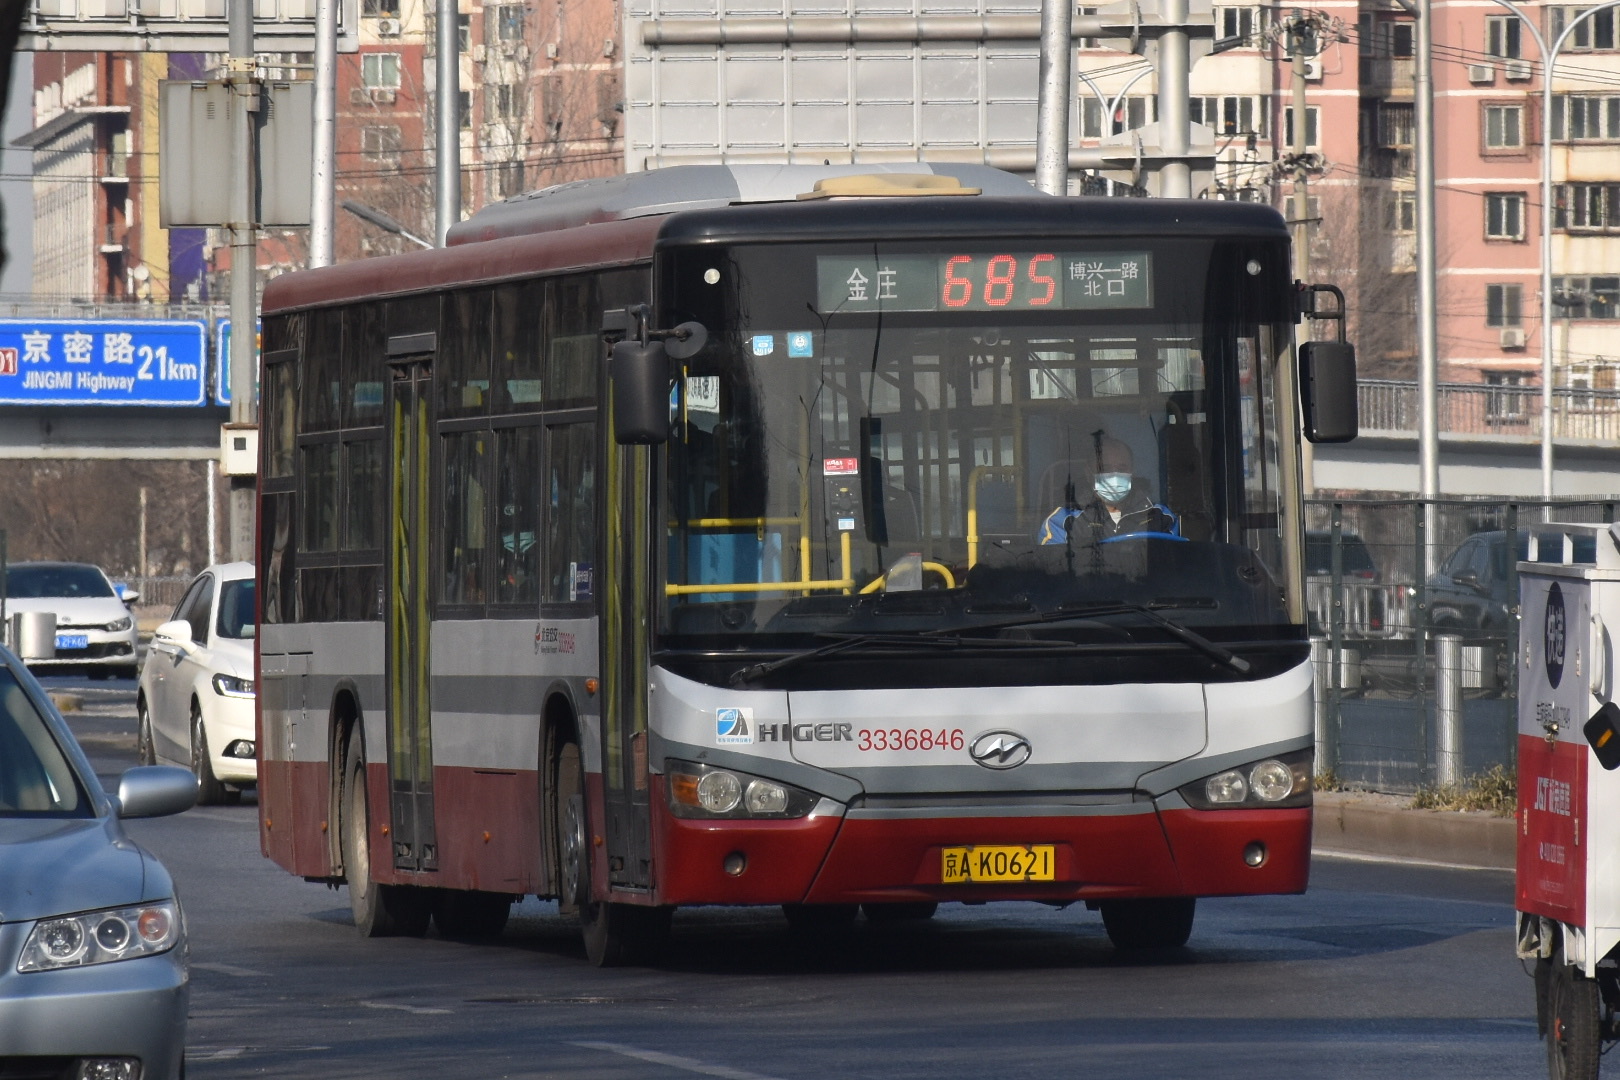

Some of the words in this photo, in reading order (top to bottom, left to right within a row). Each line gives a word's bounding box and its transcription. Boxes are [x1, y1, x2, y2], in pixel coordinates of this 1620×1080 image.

[942, 253, 1056, 307] 685
[1069, 261, 1139, 280] 博兴一路
[846, 266, 898, 301] 金庄
[1084, 279, 1126, 297] 北口
[22, 330, 134, 364] 京密路
[137, 346, 197, 381] 21km
[22, 371, 72, 390] JINGMI
[77, 372, 135, 394] Highway
[758, 721, 853, 743] HIGER
[857, 728, 965, 752] 3336846
